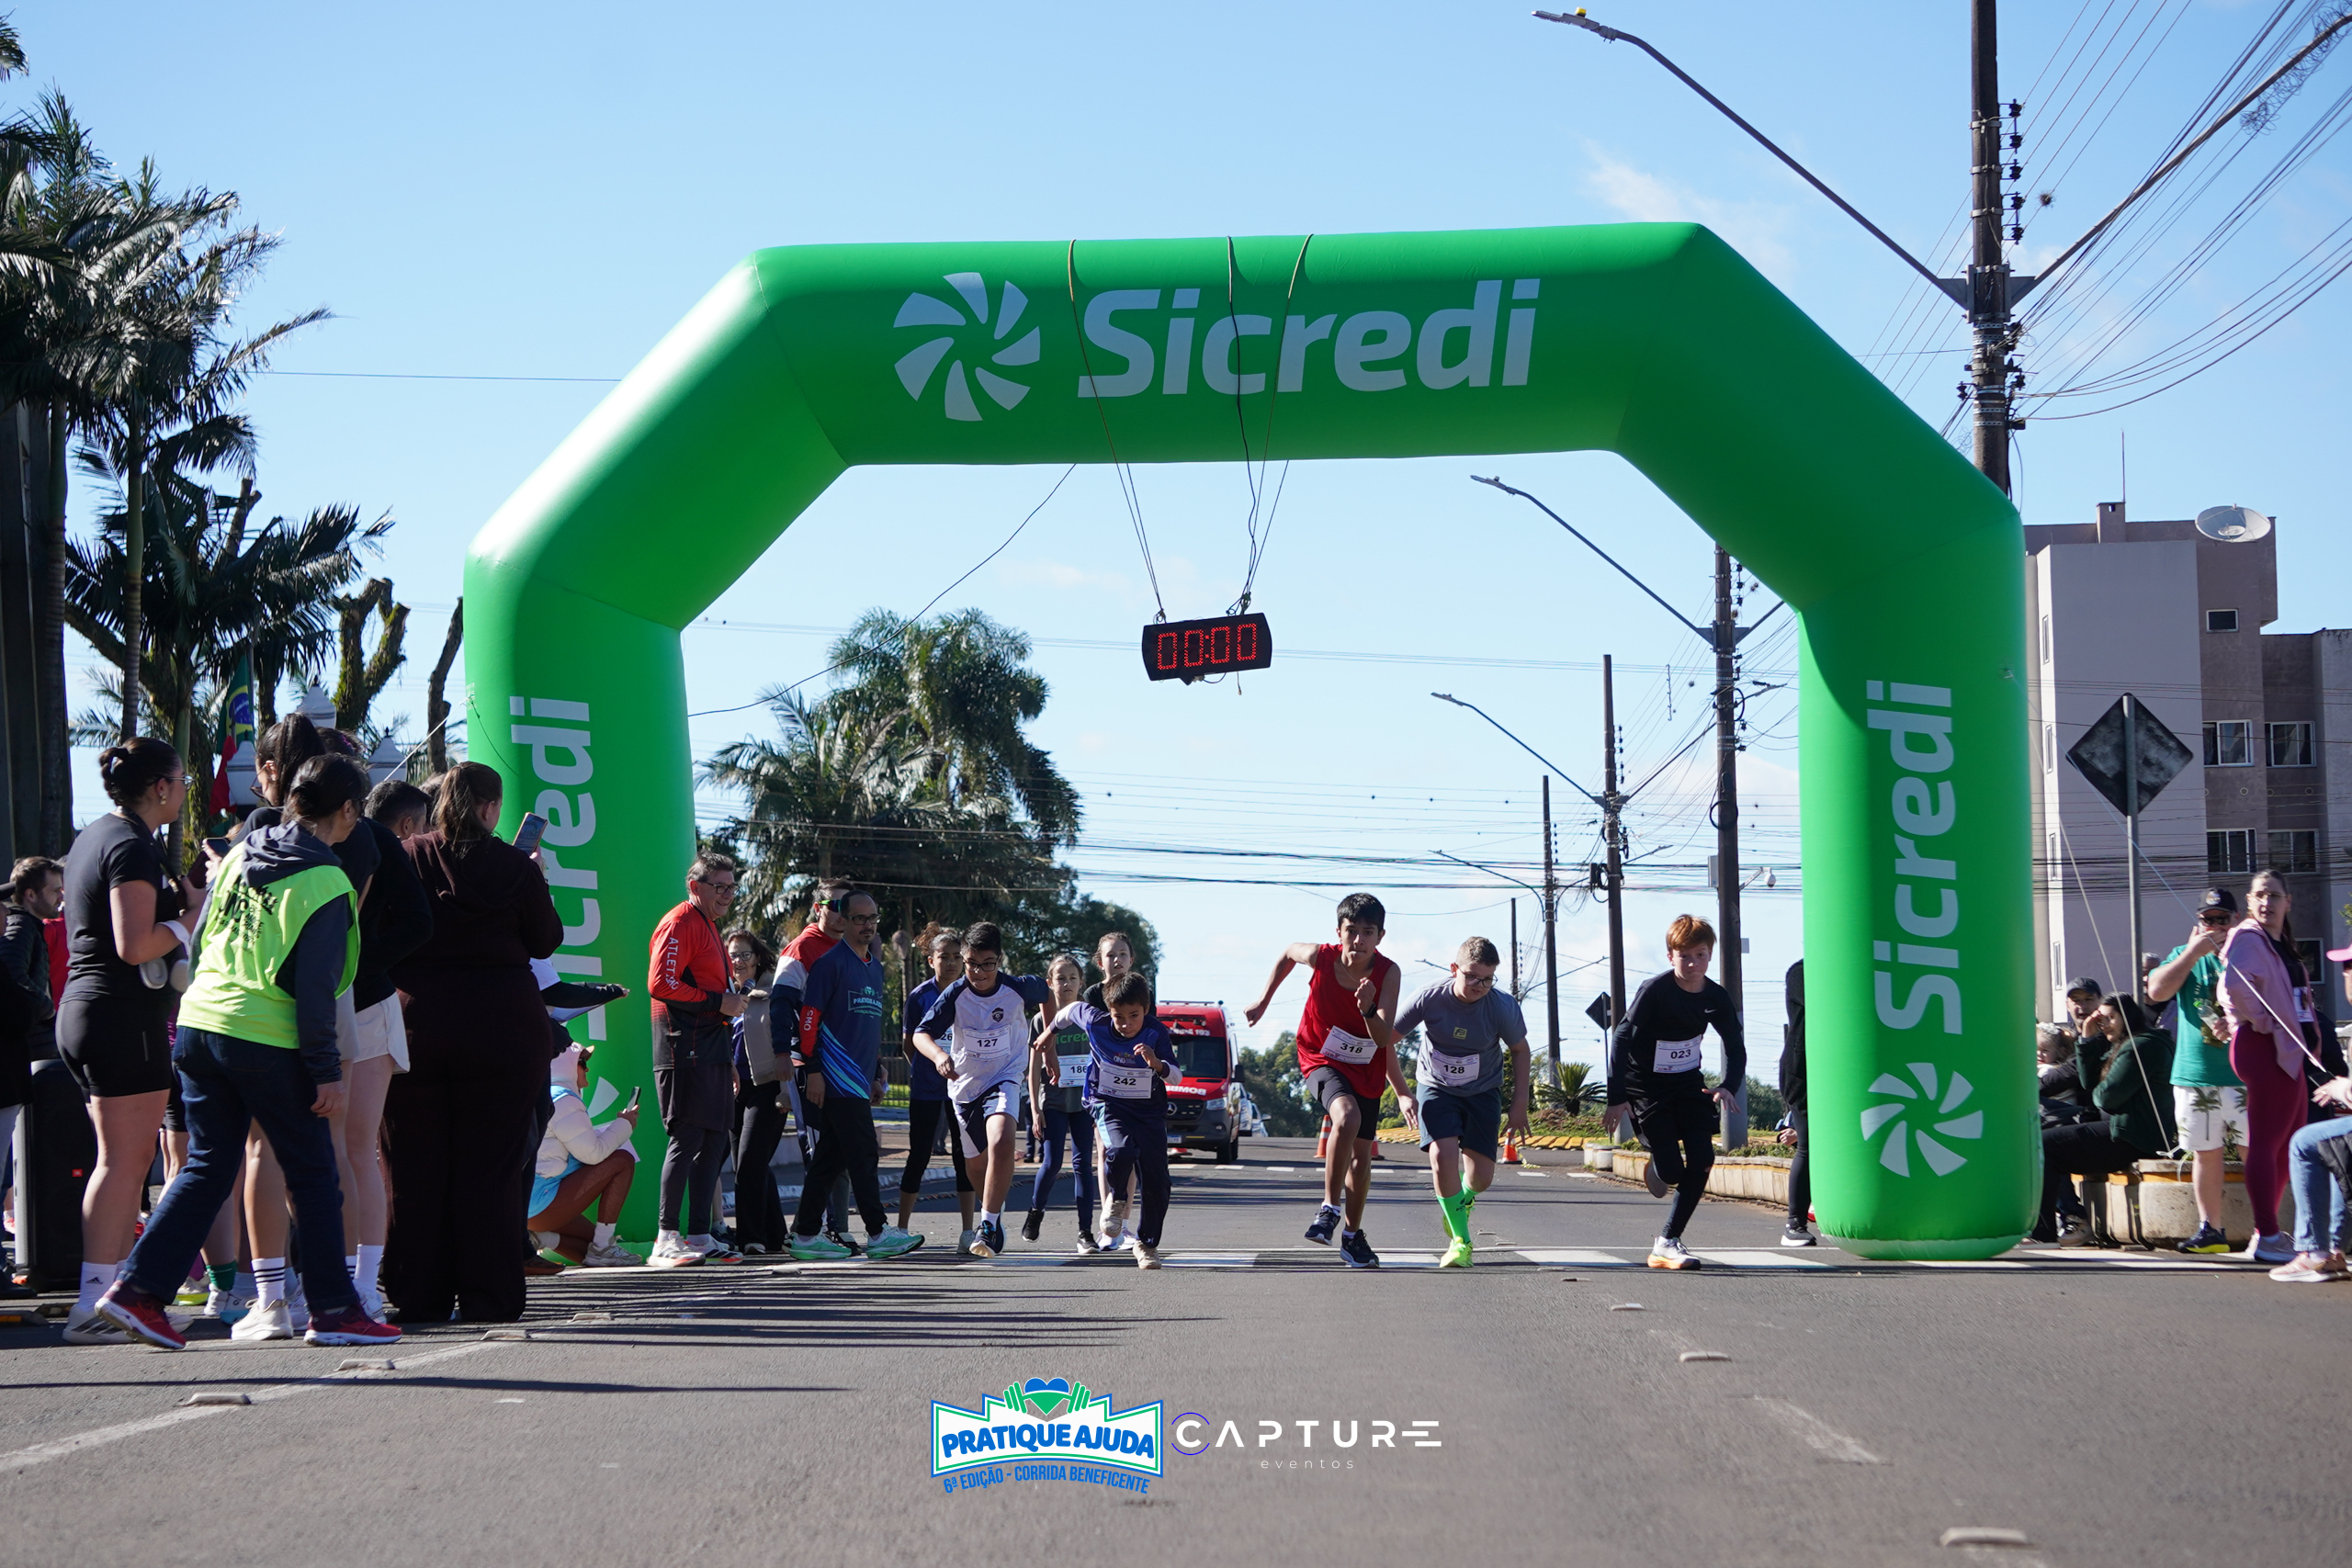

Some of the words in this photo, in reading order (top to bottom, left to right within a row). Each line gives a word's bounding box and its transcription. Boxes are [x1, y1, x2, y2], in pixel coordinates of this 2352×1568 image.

[1077, 278, 1541, 398] Sicredi
[1157, 623, 1257, 671] 00:00
[1866, 679, 1962, 1035] Sicredi
[509, 695, 607, 1042] icredi
[940, 1032, 953, 1041] 26
[977, 1038, 998, 1048] 127
[1340, 1043, 1363, 1054] 318
[1670, 1049, 1691, 1059] 023
[1443, 1065, 1465, 1074] 128
[1113, 1076, 1136, 1086] 242
